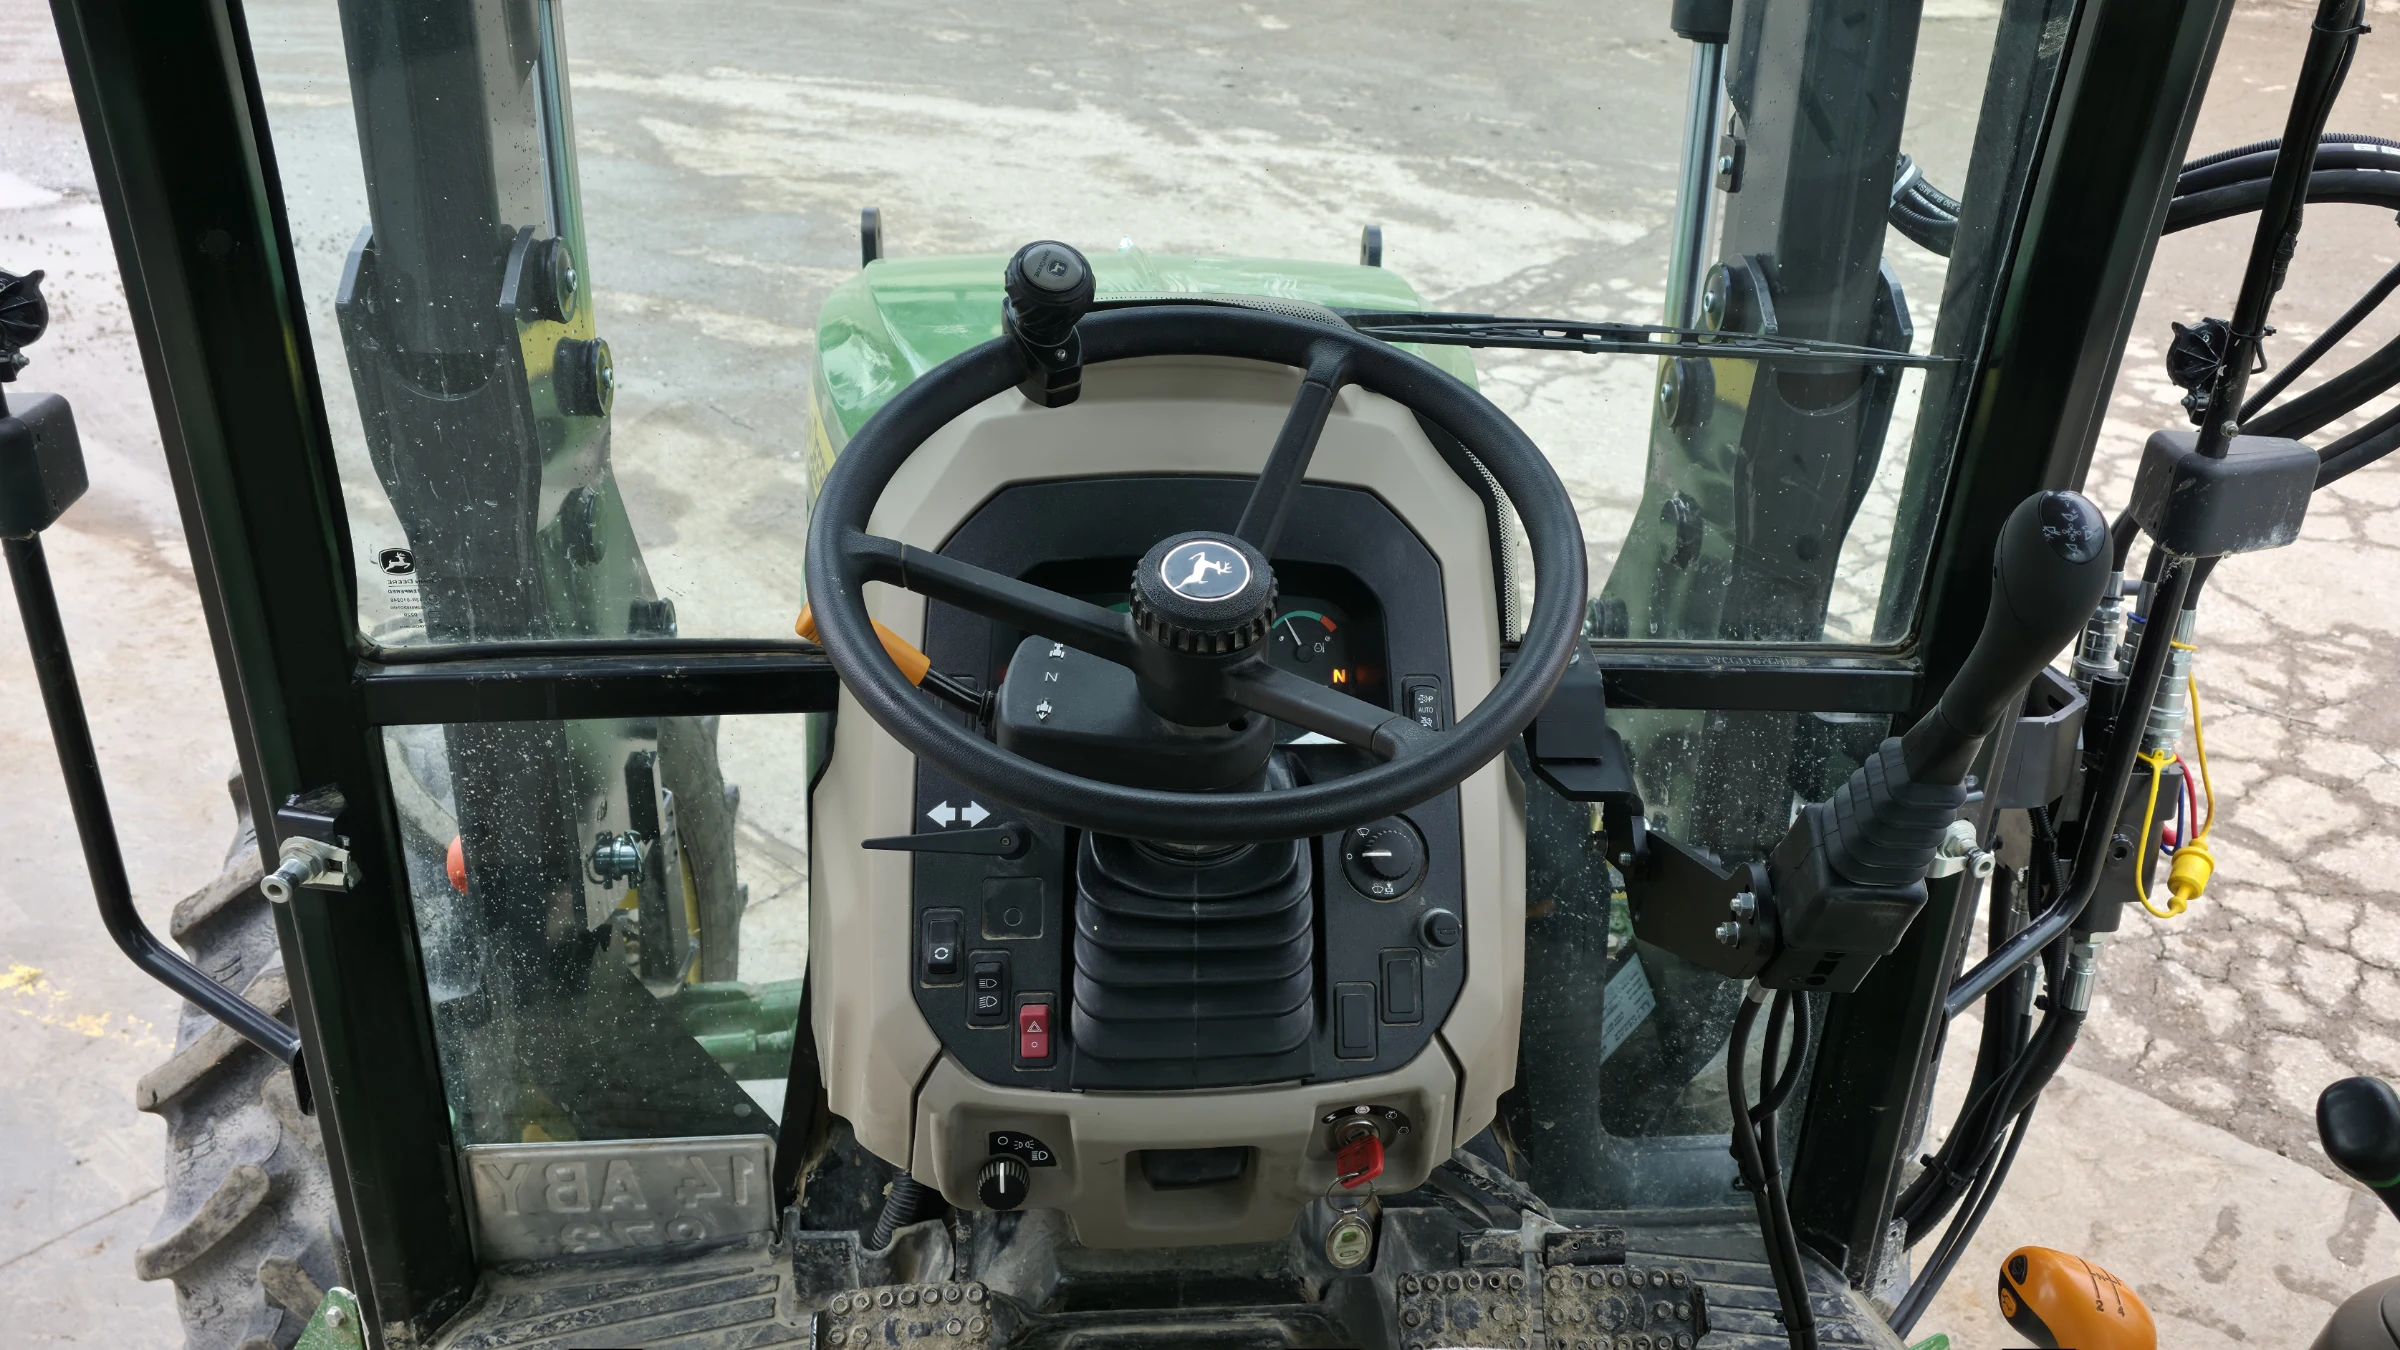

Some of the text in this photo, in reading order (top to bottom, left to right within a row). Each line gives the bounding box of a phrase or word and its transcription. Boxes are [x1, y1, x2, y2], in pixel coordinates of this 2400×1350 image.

[1931, 192, 1943, 203] Bar
[1943, 199, 1956, 209] 330
[1044, 671, 1059, 682] N
[1333, 668, 1346, 684] N
[1418, 706, 1434, 714] AUTO
[2095, 1299, 2105, 1312] 2
[2117, 1305, 2126, 1318] 4
